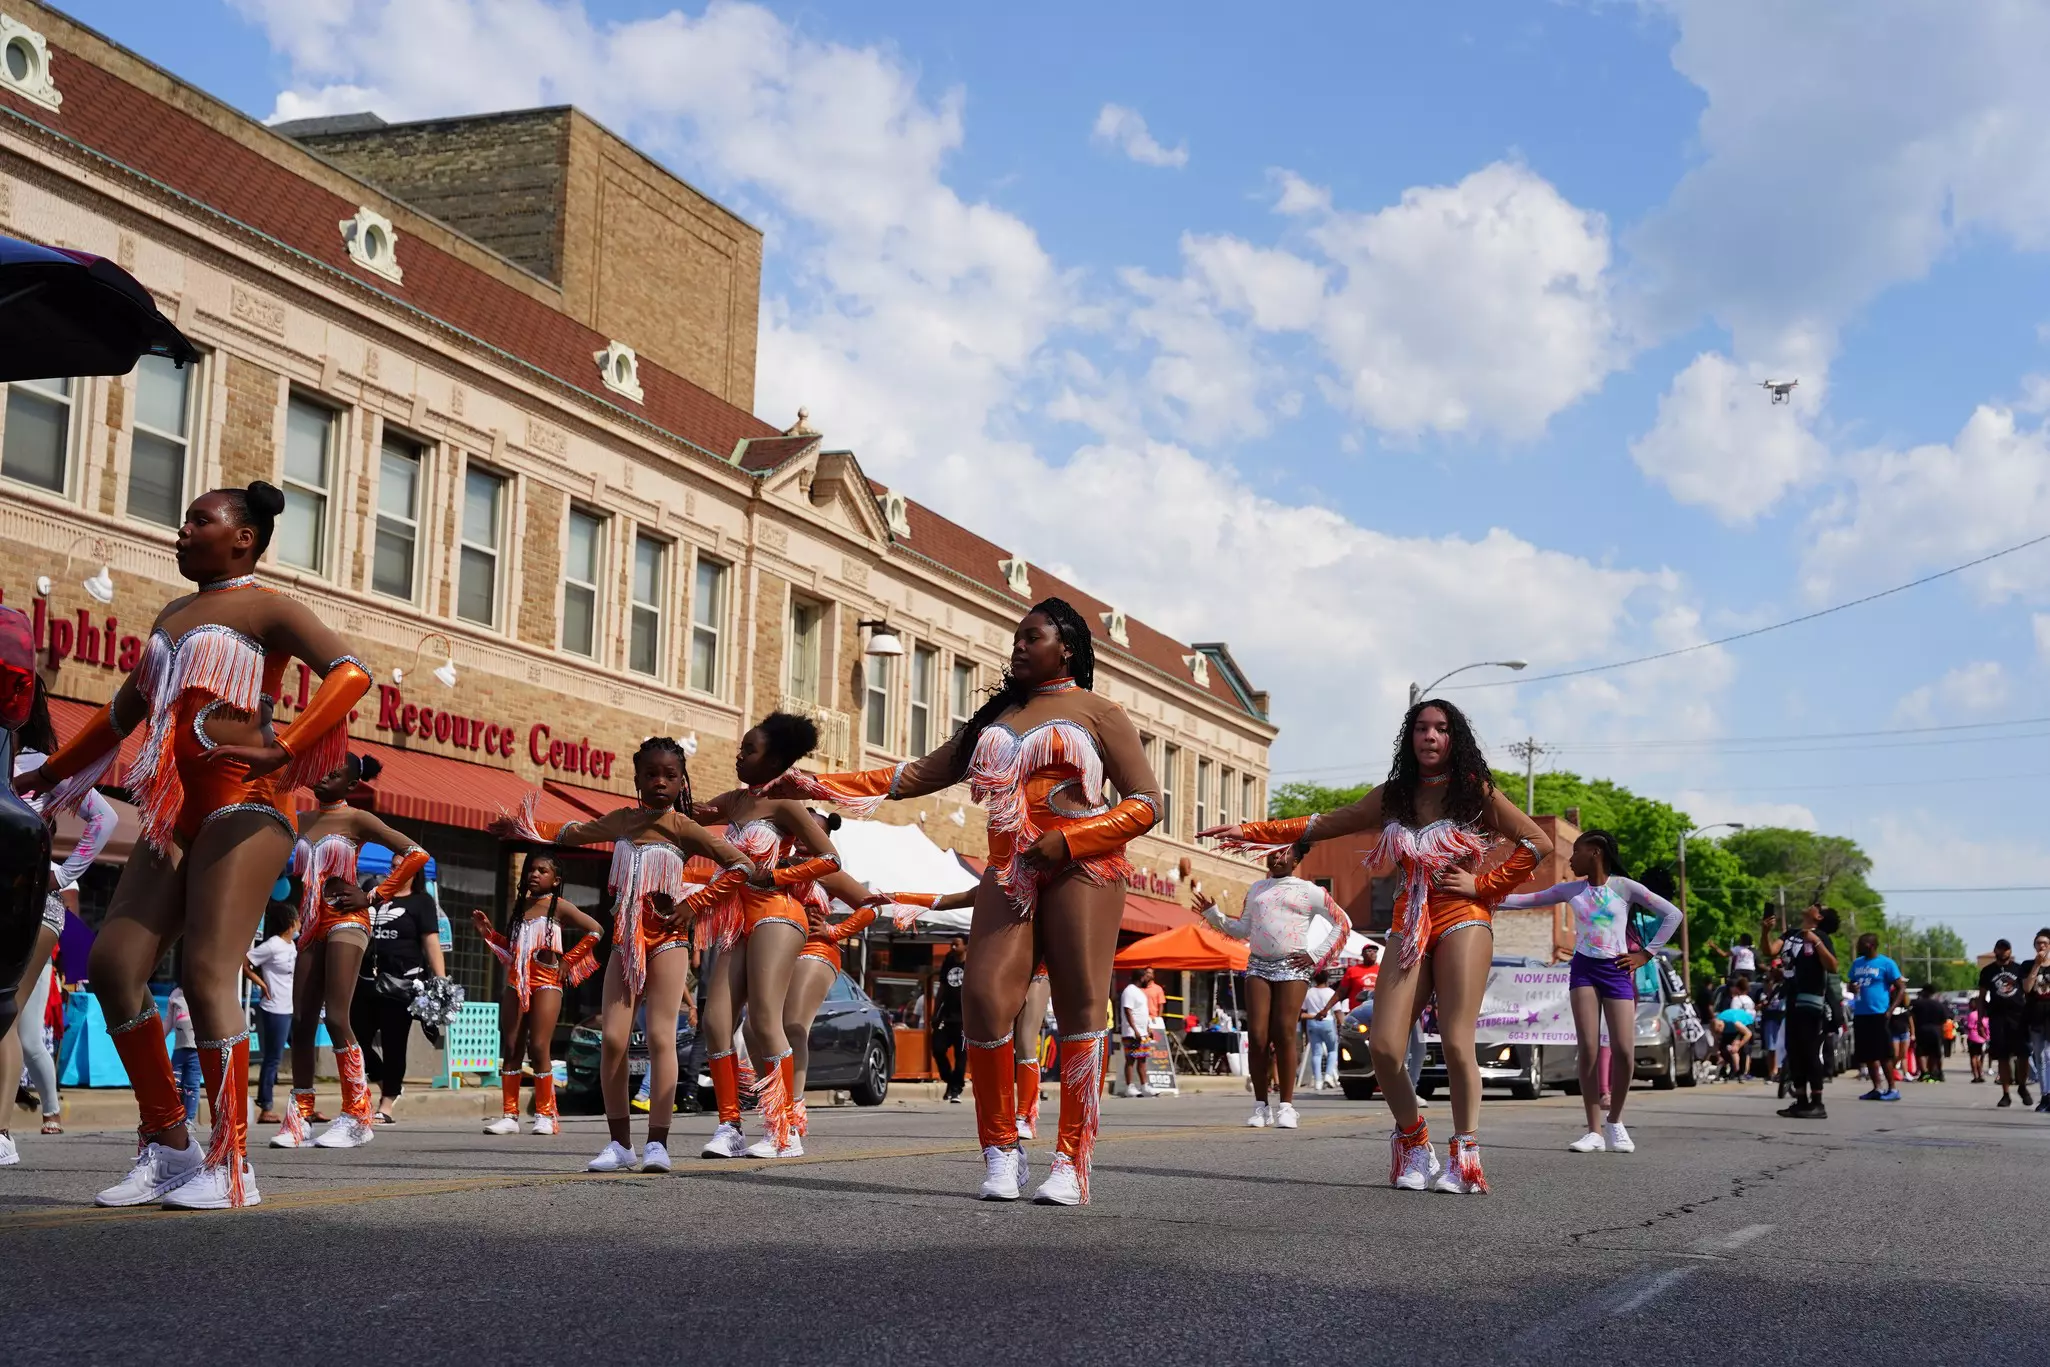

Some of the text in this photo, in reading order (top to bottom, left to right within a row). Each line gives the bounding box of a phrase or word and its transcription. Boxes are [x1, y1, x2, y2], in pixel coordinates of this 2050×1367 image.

[12, 598, 141, 673] lphia
[376, 684, 515, 758] Resource
[529, 723, 616, 780] Center
[1514, 973, 1570, 984] NOW ENR
[1508, 1031, 1528, 1040] 6043
[1532, 1032, 1539, 1040] N
[1542, 1032, 1577, 1041] TEUTON
